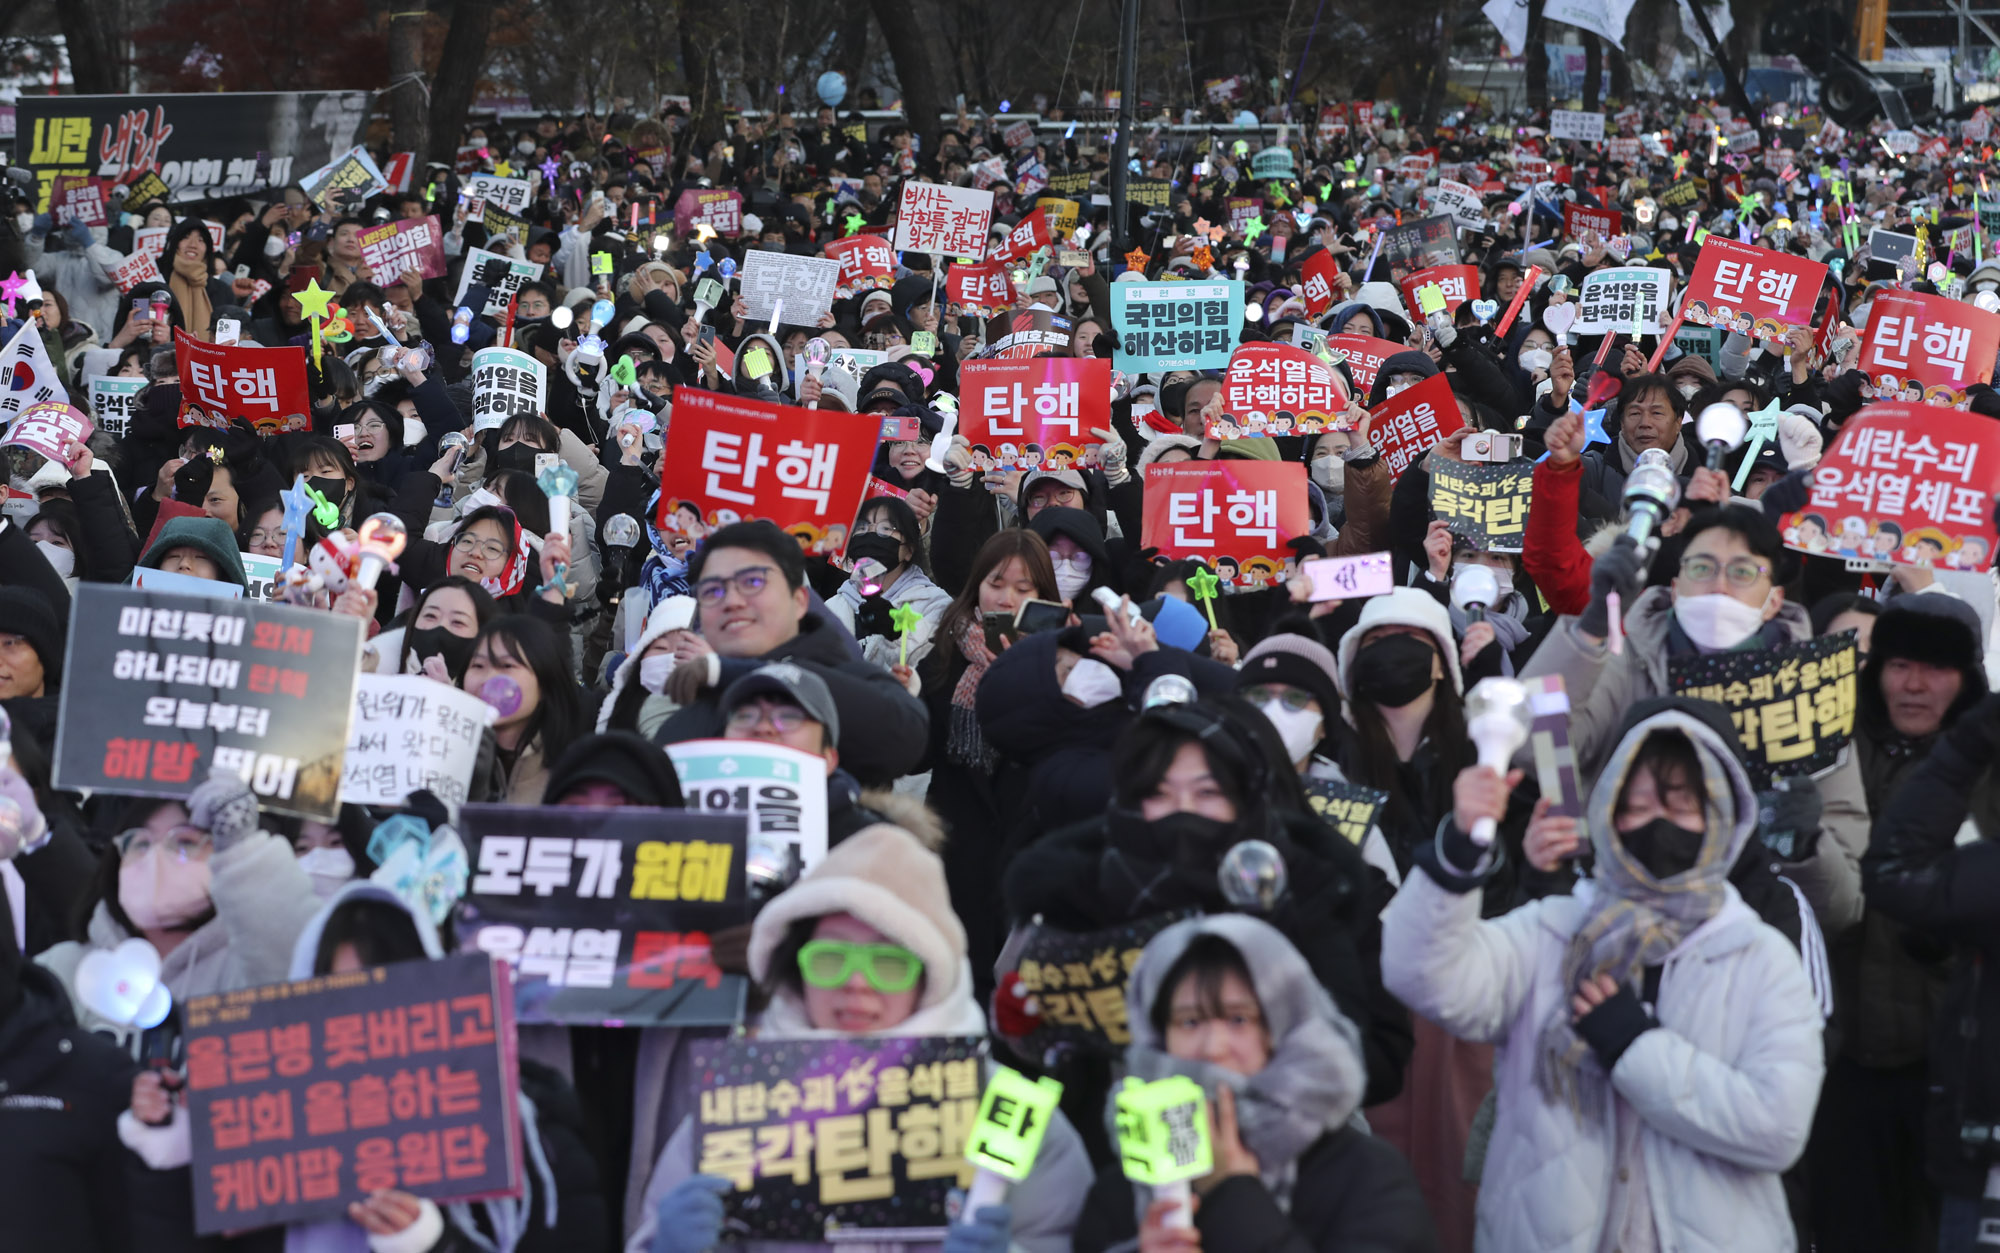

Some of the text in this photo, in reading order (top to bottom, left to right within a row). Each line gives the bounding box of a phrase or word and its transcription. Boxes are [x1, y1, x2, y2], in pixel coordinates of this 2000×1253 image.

[29, 117, 92, 164] 내란
[476, 181, 524, 206] 윤석열
[905, 186, 953, 210] 역사는
[362, 222, 432, 265] 국민의힘
[900, 207, 990, 234] 너희를 절대
[910, 227, 987, 256] 잊지 않는다
[992, 221, 1038, 261] 탄핵
[839, 243, 893, 279] 탄핵
[961, 272, 1009, 302] 탄핵
[1585, 283, 1658, 303] 윤석열을
[1713, 260, 1798, 316] 탄핵
[1014, 330, 1042, 344] 비호
[1125, 300, 1228, 328] 국민의힘
[1125, 329, 1231, 356] 해산하라
[1873, 315, 1972, 381] 탄핵
[190, 360, 279, 412] 탄핵
[1229, 358, 1331, 386] 윤석열을
[715, 404, 778, 421] www.nanum.com
[984, 382, 1079, 436] 탄핵
[1229, 385, 1335, 411] 탄핵하라
[1370, 402, 1439, 456] 윤석열을
[702, 430, 840, 515] 탄핵
[1175, 469, 1222, 477] www.nanum.com
[1839, 427, 1980, 483] 내란수괴
[1435, 473, 1497, 497] 내란수괴
[1810, 467, 1987, 527] 윤석열 체포
[1169, 489, 1277, 549] 탄핵
[118, 606, 314, 656] 미친듯이 외쳐
[114, 651, 310, 699] 하나되어 탄핵
[1799, 646, 1856, 690] 윤석열
[144, 697, 271, 737] 오늘부터
[103, 736, 200, 783] 해방
[473, 836, 733, 902] 모두가 원해
[477, 925, 621, 988] 윤석열
[324, 994, 496, 1070] 못버리고
[700, 1057, 979, 1125] 내란수괴 윤석열
[210, 1089, 293, 1150] 집회
[978, 1095, 1036, 1166] 탄
[211, 1124, 488, 1213] 케이팝 응원단
